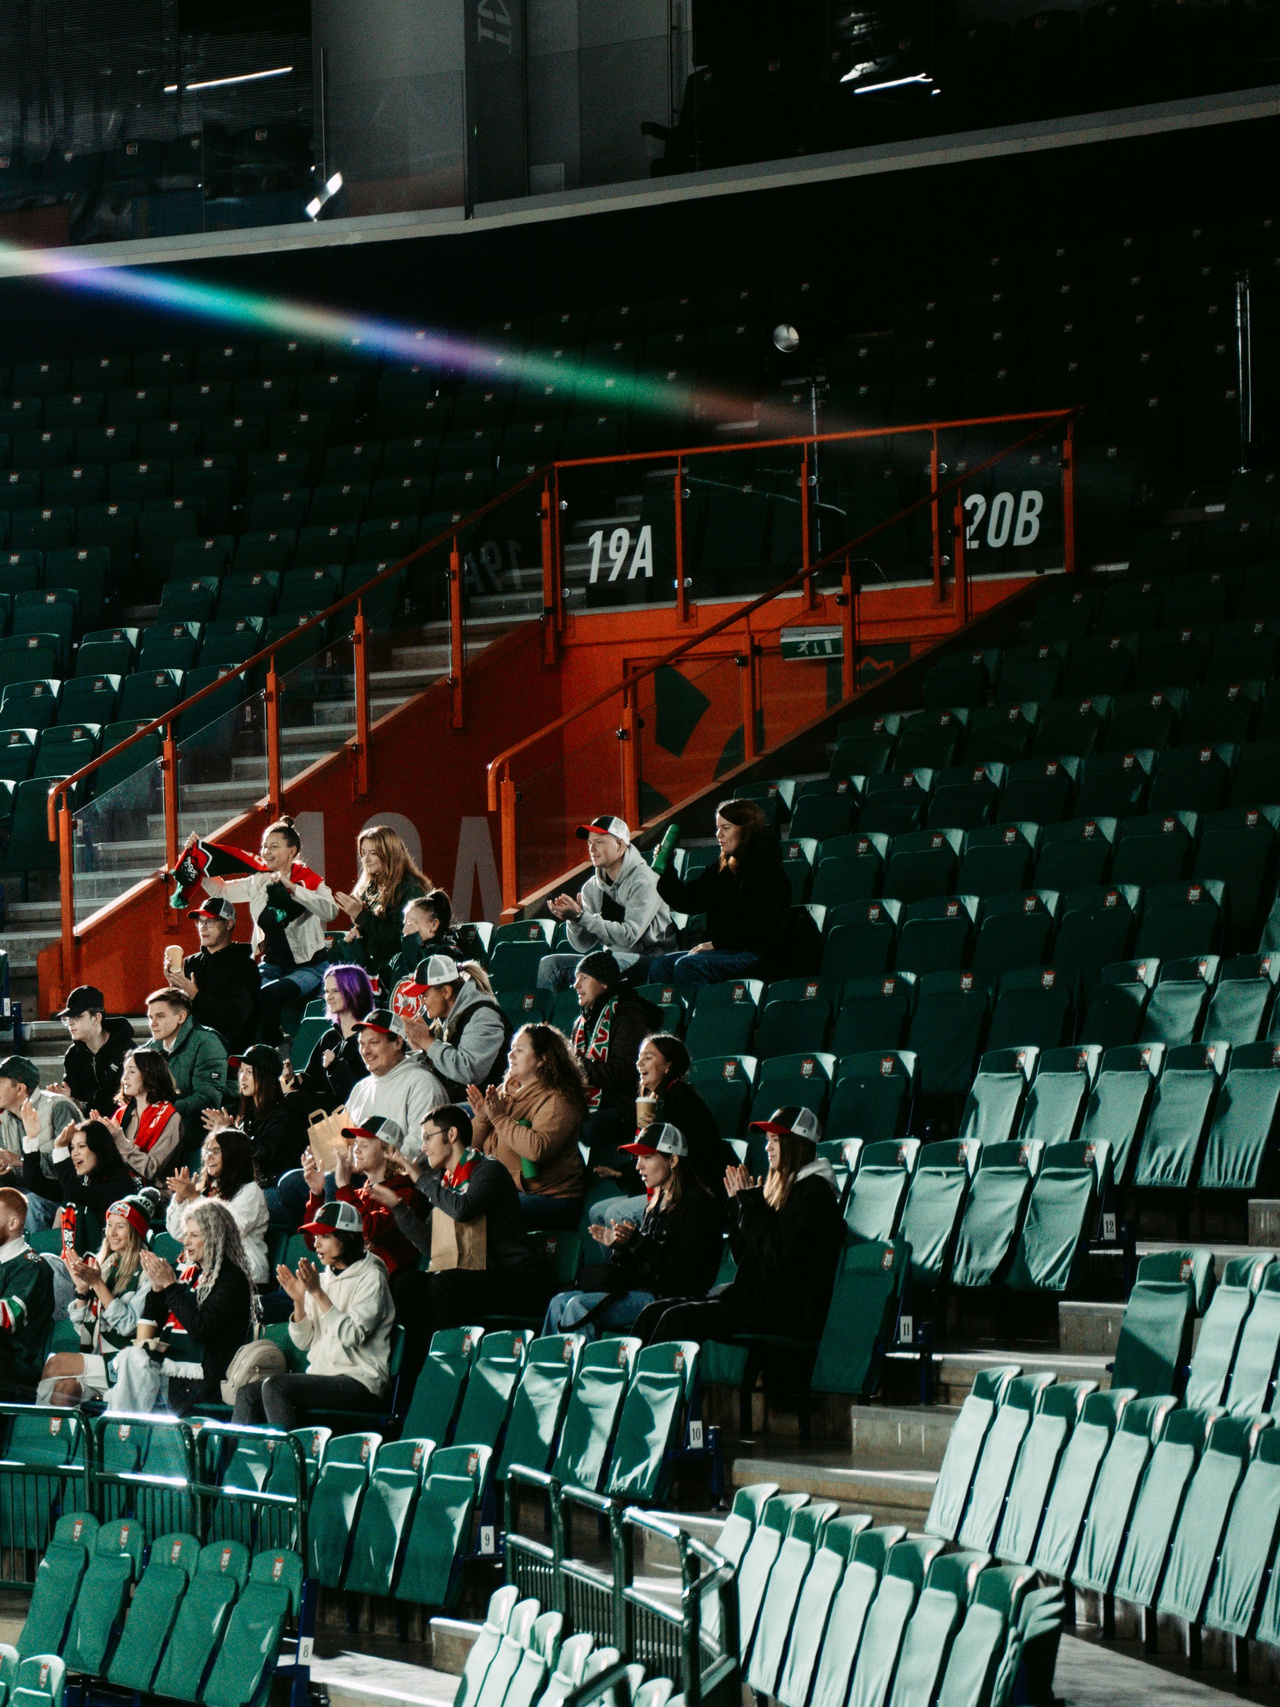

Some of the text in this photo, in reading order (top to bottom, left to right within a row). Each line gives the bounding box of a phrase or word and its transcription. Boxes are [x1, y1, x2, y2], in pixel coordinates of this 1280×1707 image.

[963, 489, 1044, 549] 20B
[587, 525, 654, 584] 19A
[1105, 1220, 1115, 1233] 12
[903, 1323, 910, 1336] 11
[692, 1427, 700, 1440] 10
[484, 1533, 490, 1546] 9
[303, 1644, 310, 1658] 8
